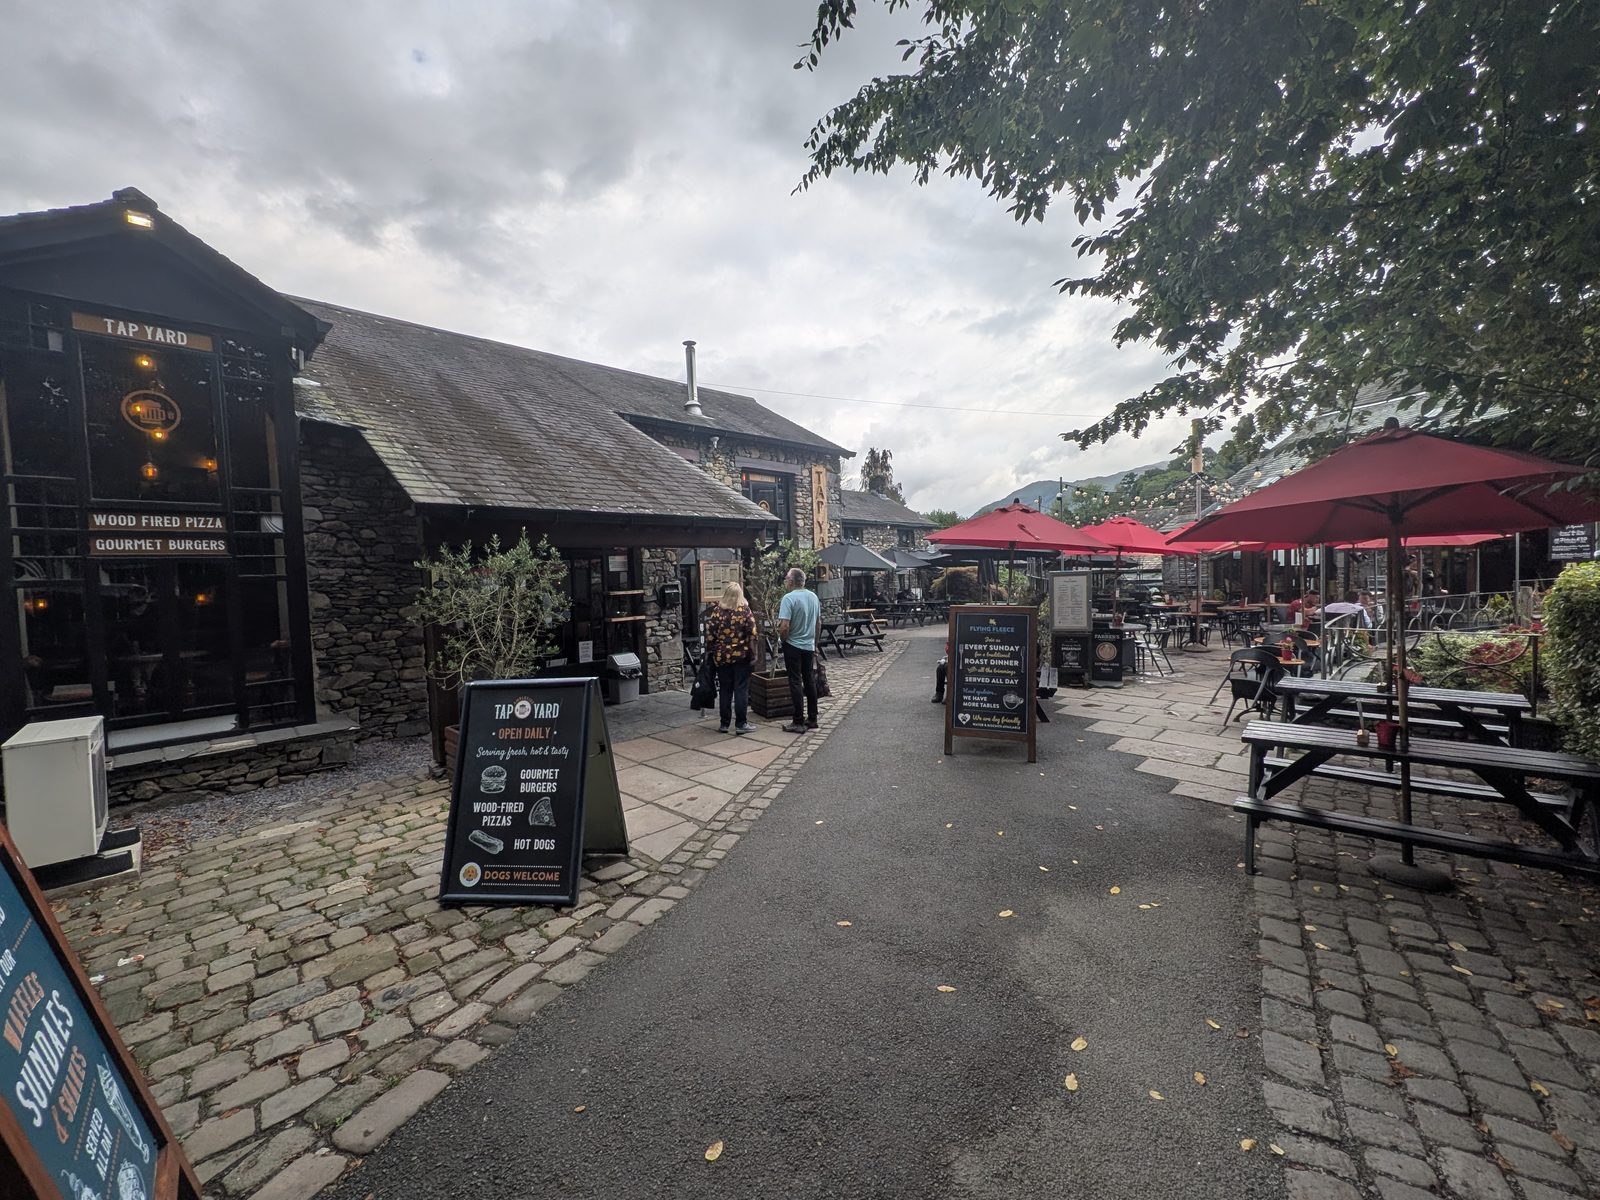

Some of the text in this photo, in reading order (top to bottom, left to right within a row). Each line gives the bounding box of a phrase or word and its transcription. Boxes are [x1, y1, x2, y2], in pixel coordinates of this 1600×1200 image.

[104, 318, 188, 346] TAP YARD
[93, 514, 223, 528] WOOD FIRED PIZZA
[814, 471, 828, 580] TAP YAD
[95, 539, 226, 551] GOURMET BURGERS
[989, 644, 1020, 652] SUNDAY
[494, 703, 560, 719] TAP YARD
[992, 716, 1001, 724] dog
[1001, 716, 1021, 726] friendly
[498, 727, 552, 740] OPEN DAILY
[476, 745, 569, 760] Serving fresh, hot & tasty
[520, 768, 560, 780] GOURMET
[520, 782, 558, 793] BURGERS
[473, 802, 524, 813] WOOD-FIRED
[482, 816, 512, 826] PIZZAS
[514, 839, 556, 850] HOT DOGS
[484, 870, 560, 880] DOGS WELCOME
[3, 971, 45, 1054] WAFFLES
[15, 989, 74, 1127] SUNDAES
[58, 1045, 87, 1122] SHAKES
[86, 1107, 103, 1161] SERVED
[96, 1123, 114, 1182] ALL DAY
